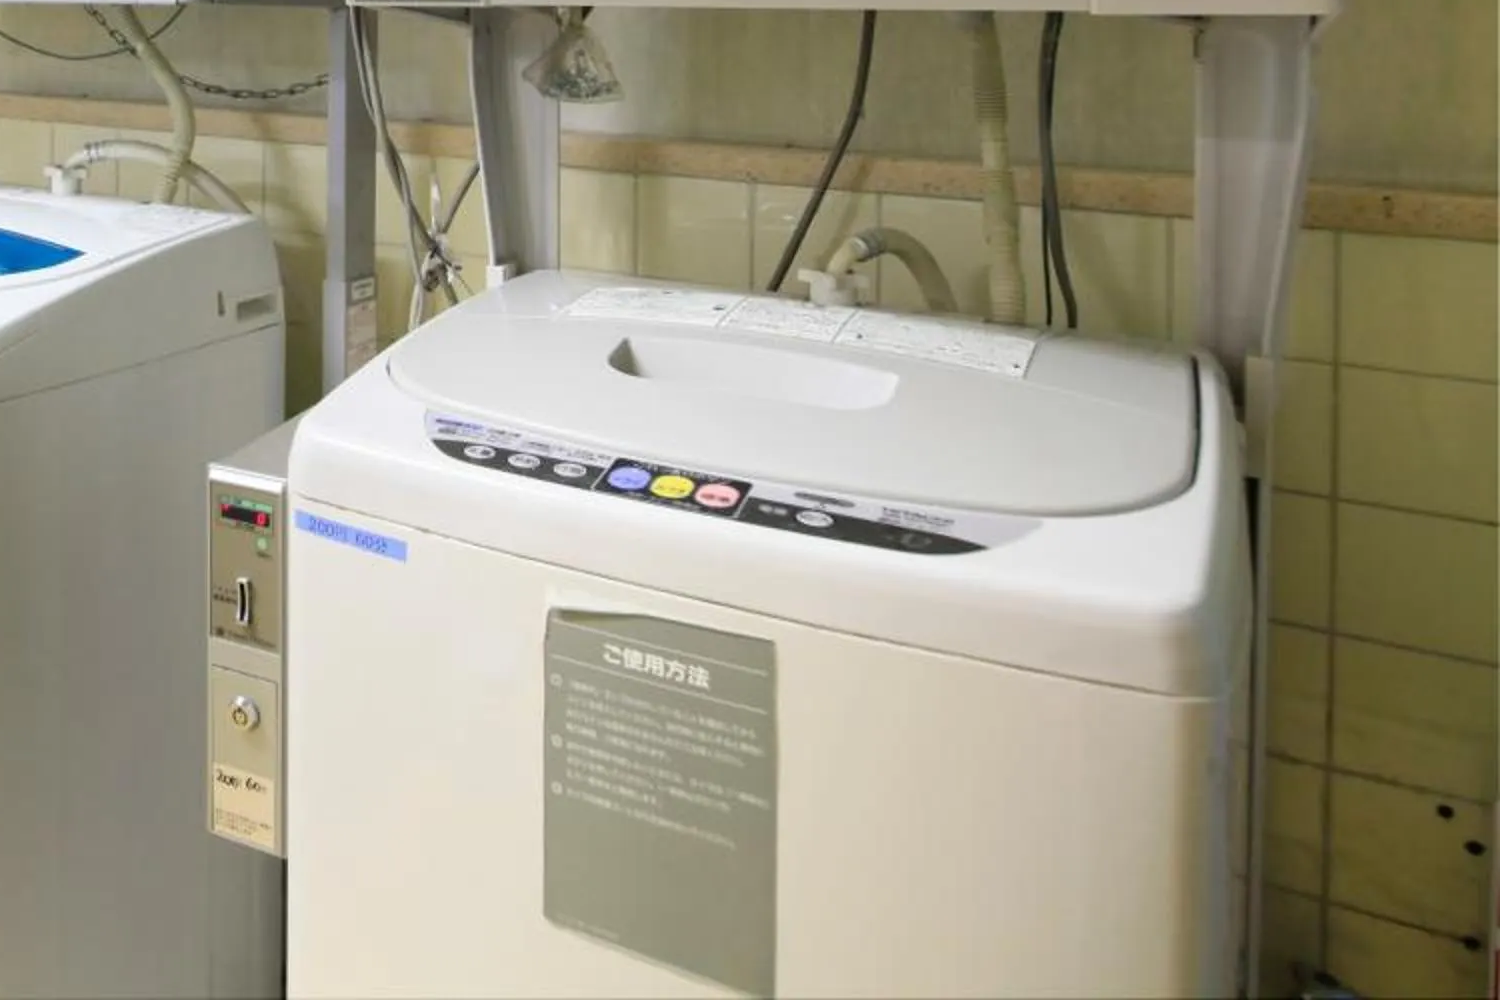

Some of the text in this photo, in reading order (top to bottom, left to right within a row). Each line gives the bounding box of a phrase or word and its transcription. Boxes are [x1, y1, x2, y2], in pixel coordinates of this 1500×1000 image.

[601, 643, 712, 690] ご使用方法
